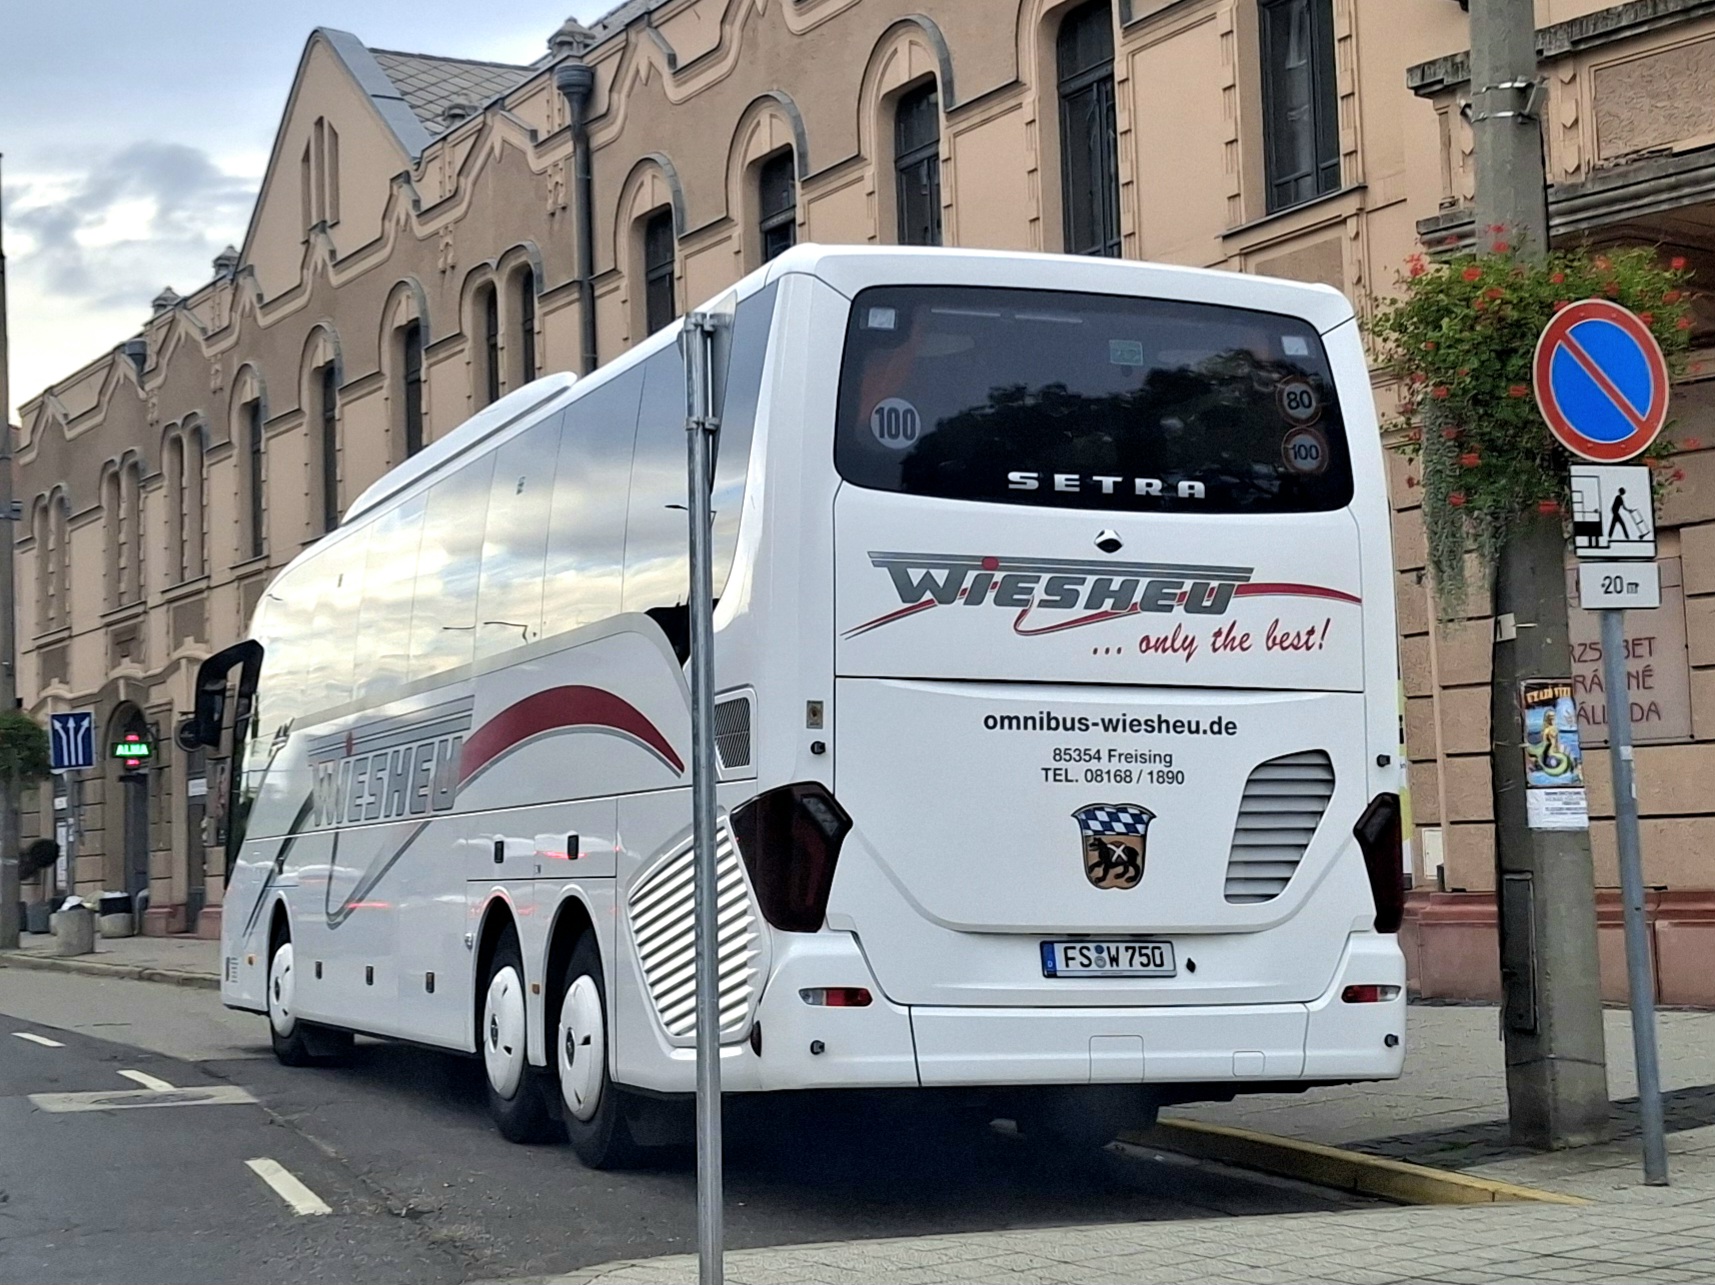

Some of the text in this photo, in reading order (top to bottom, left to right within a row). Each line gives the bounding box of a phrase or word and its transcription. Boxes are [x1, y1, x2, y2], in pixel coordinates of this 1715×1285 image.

[1286, 389, 1313, 411] 80
[875, 406, 917, 441] 100
[1291, 443, 1320, 461] 100
[1007, 471, 1206, 499] SETRA
[880, 554, 1240, 616] WIESHEU
[1602, 575, 1640, 595] 20 m
[1138, 622, 1199, 663] only
[1210, 619, 1253, 654] the
[1265, 617, 1331, 651] best!
[1568, 636, 1657, 664] RZSBET
[983, 711, 1238, 736] omnibus-wiesheu.de
[1052, 747, 1173, 768] 85354 Freising
[1041, 767, 1079, 783] TEL.
[1084, 768, 1134, 784] 08168
[1147, 769, 1186, 785] 1890
[1063, 945, 1093, 968] FS
[1106, 945, 1120, 968] W
[1125, 945, 1165, 968] 750
